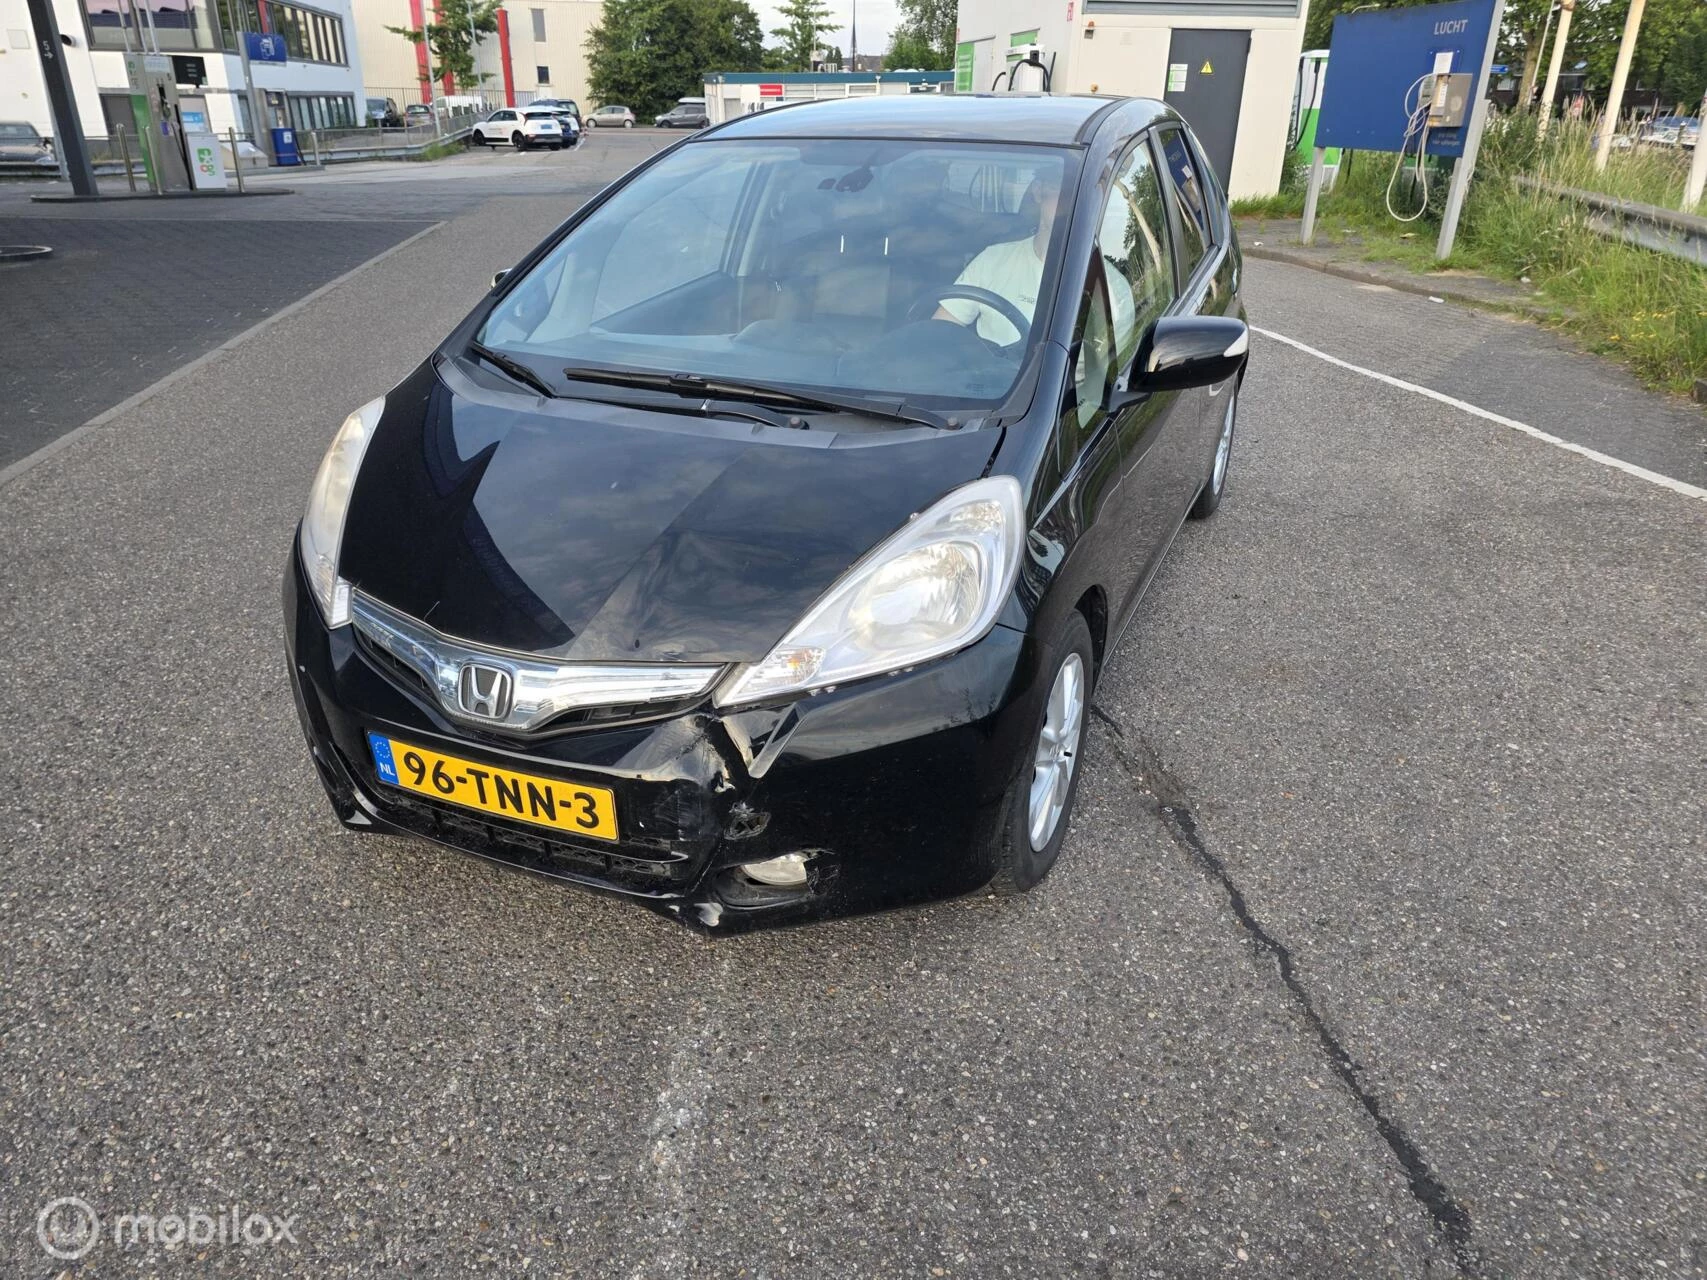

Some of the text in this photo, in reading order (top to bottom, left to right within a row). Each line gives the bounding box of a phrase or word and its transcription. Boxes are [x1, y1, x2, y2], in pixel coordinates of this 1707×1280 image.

[1434, 19, 1468, 35] LUCHT
[379, 763, 396, 777] NL
[403, 751, 600, 829] 96-TNN-3
